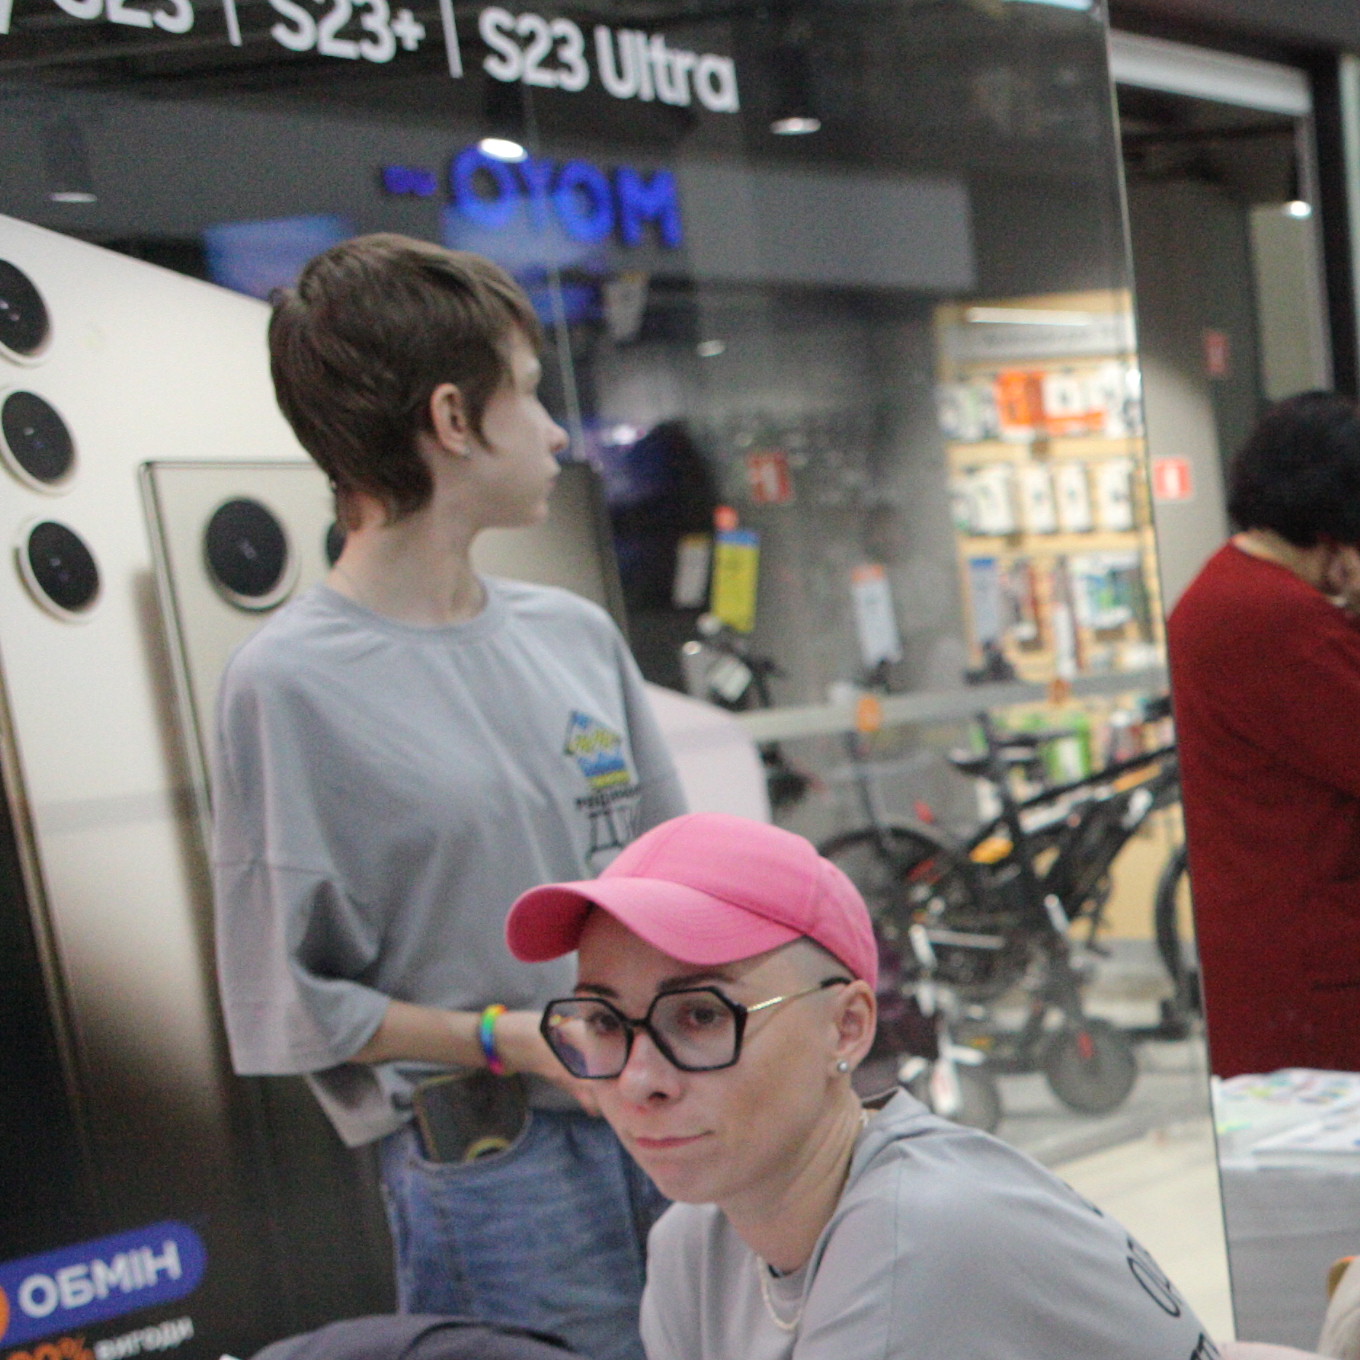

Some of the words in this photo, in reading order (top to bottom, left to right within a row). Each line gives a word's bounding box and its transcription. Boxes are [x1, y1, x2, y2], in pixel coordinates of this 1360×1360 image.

[479, 6, 590, 92] S23
[594, 24, 740, 113] Ultra
[17, 1238, 183, 1319] ОБМІН
